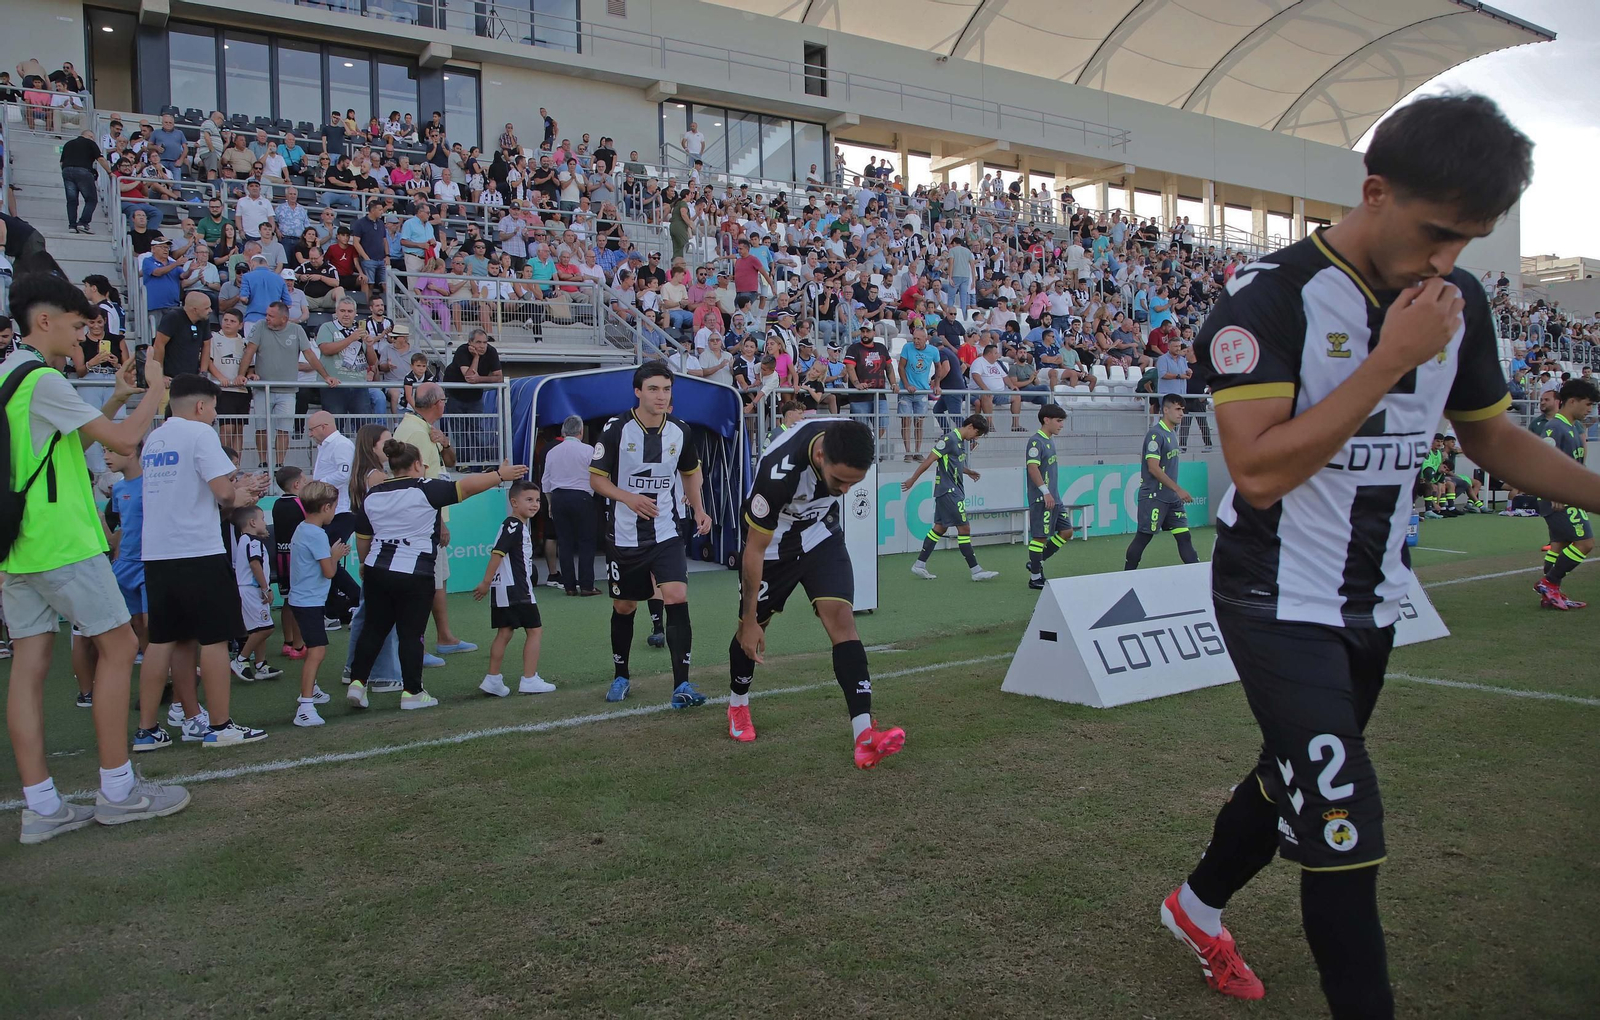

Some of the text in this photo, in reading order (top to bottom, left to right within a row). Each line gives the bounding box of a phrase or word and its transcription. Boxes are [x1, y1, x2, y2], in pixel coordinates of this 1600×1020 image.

[628, 477, 670, 489] LOTUS
[610, 560, 620, 581] 6
[1093, 621, 1226, 676] LOTUS
[1308, 733, 1355, 801] 2
